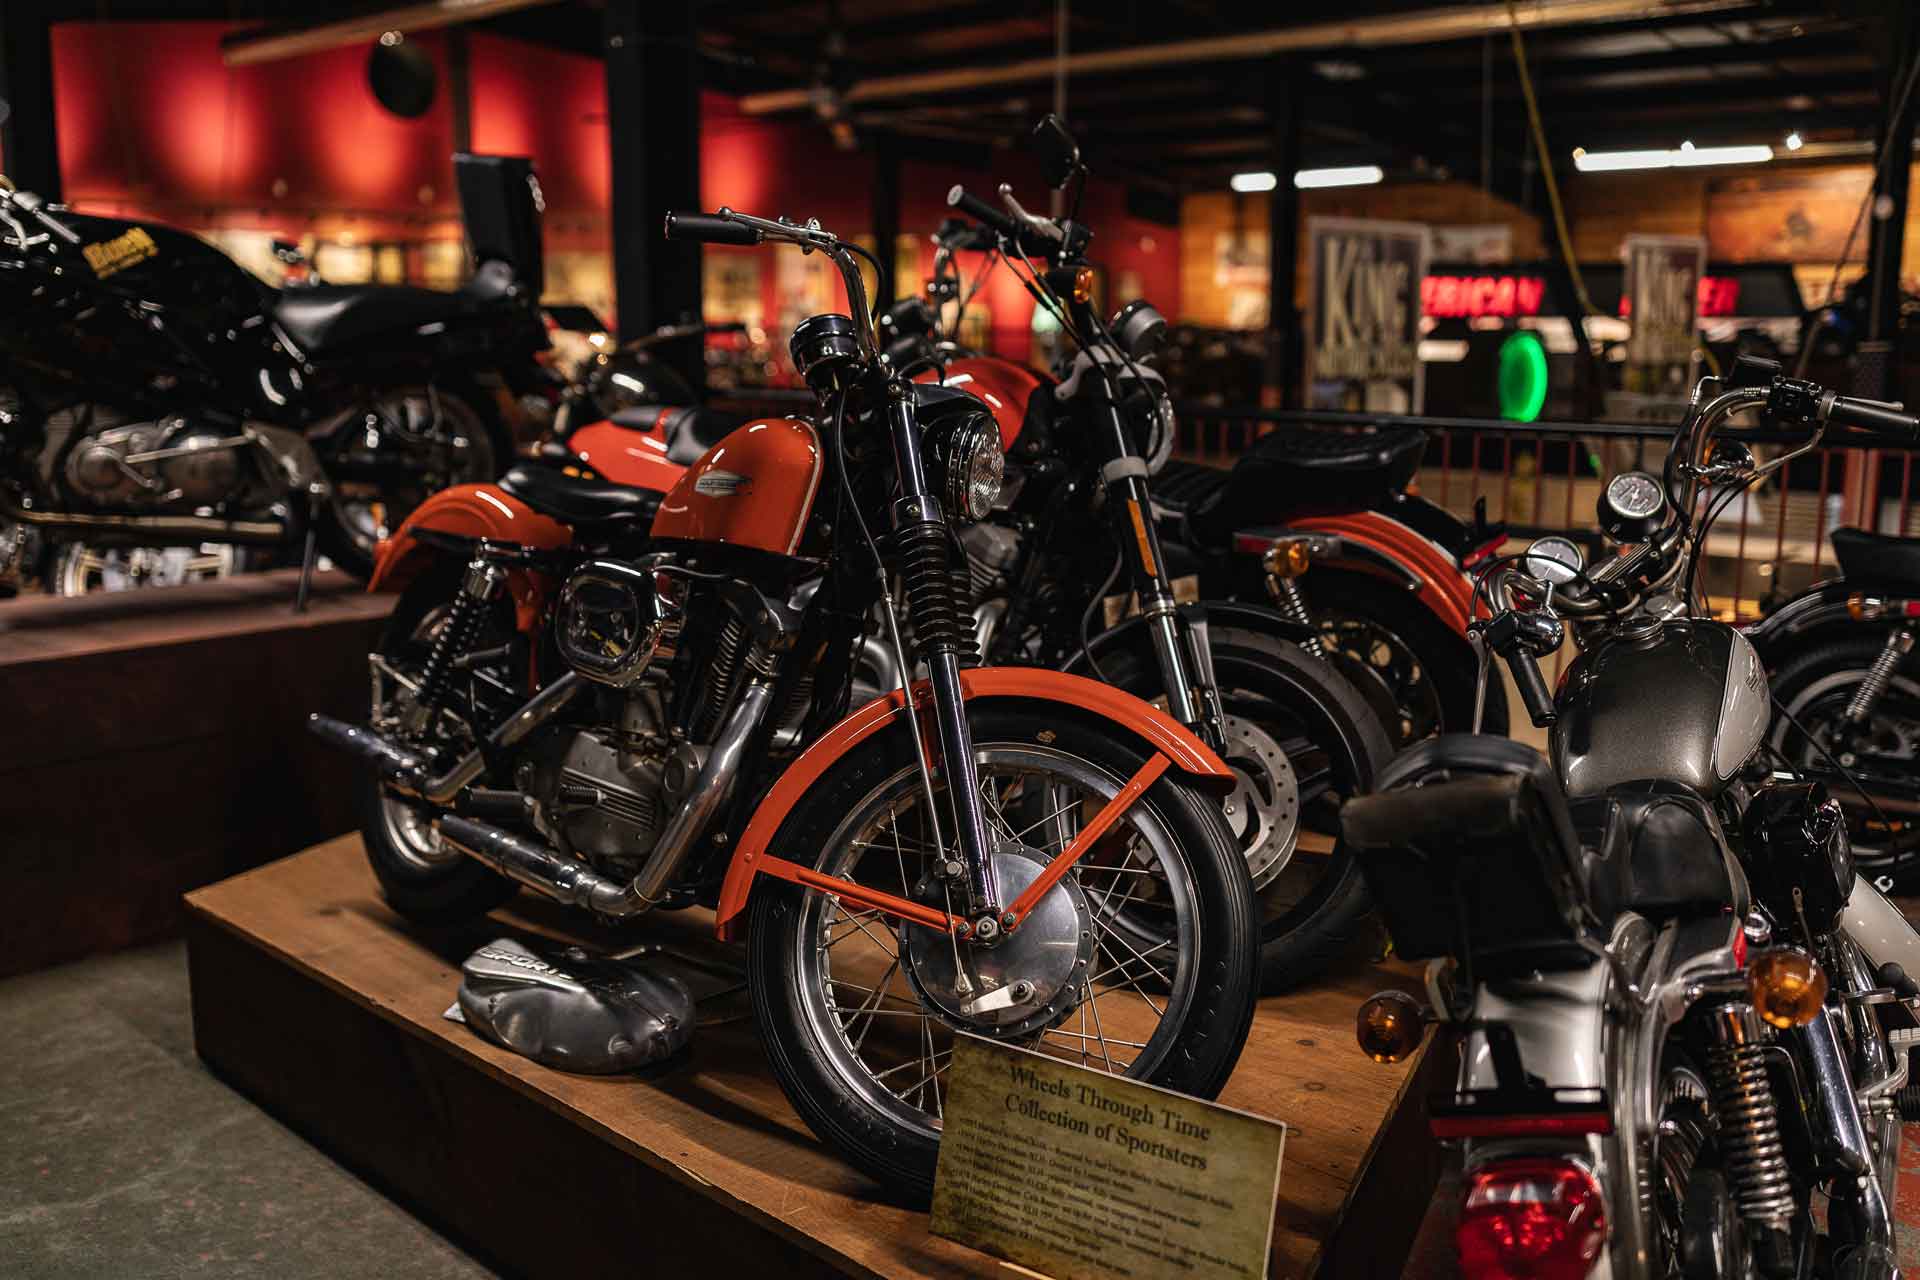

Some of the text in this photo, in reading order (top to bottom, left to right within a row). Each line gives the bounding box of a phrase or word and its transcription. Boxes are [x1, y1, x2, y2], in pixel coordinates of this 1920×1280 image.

[1005, 1092, 1089, 1136] Collection
[1094, 1122, 1113, 1143] of
[1115, 1127, 1208, 1171] Sportsters
[1008, 1065, 1211, 1141] Wheels Through Time
